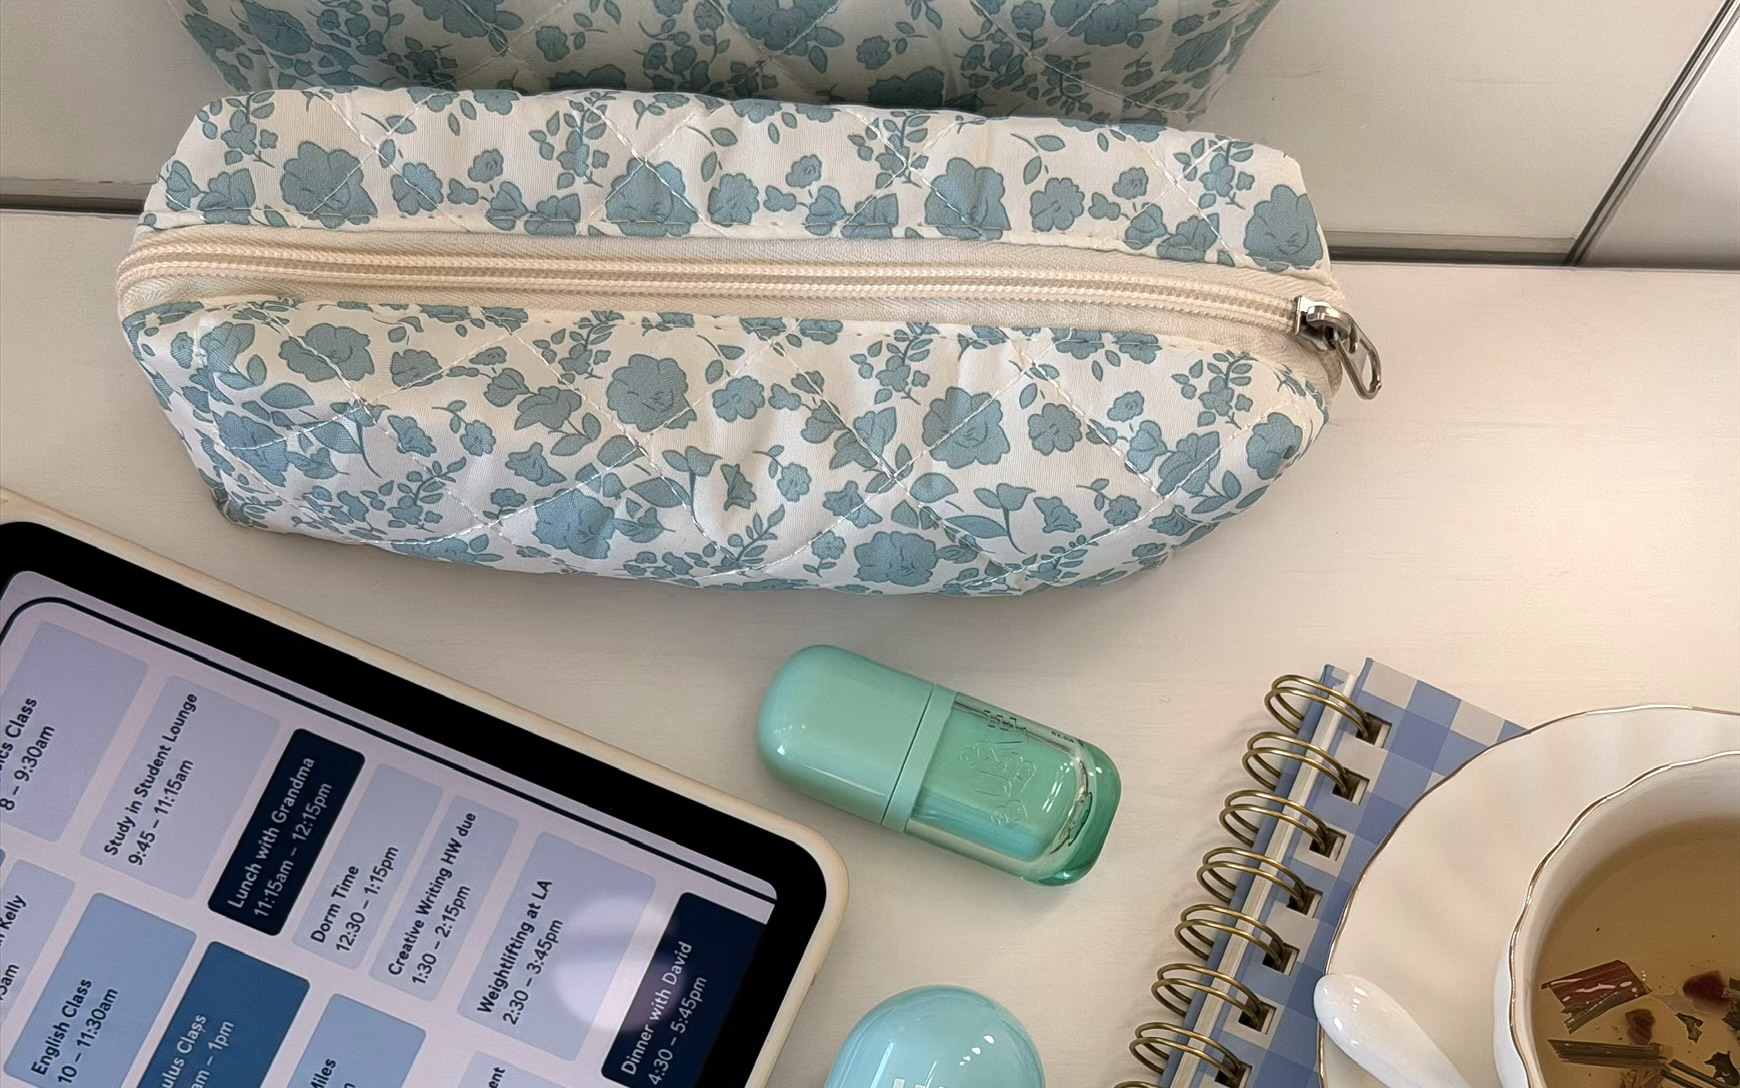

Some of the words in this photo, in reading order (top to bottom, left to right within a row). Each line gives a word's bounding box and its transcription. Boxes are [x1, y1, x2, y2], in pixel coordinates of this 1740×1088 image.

[5, 698, 37, 738] Class
[161, 693, 198, 743] Lounge
[0, 798, 15, 811] 8
[14, 726, 55, 782] 9:30am
[124, 800, 143, 814] in
[133, 744, 172, 798] Student
[103, 815, 136, 856] Study
[128, 830, 156, 866] 9:45
[153, 760, 194, 815] 11:15am
[227, 863, 262, 908] Lunch
[255, 827, 280, 859] with
[271, 758, 315, 823] Grandma
[254, 860, 294, 916] 11:15am
[292, 783, 332, 841] 12:15pm
[0, 895, 27, 930] Kelly
[310, 903, 341, 943] Dorm
[330, 865, 359, 899] Time
[335, 911, 366, 951] 12:30
[363, 846, 399, 895] 1:15pm
[388, 919, 425, 975] Creative
[415, 867, 453, 915] Writing
[440, 837, 463, 865] HW
[455, 812, 477, 837] due
[411, 953, 437, 984] 1:30
[434, 885, 471, 938] 2:15pm
[526, 902, 542, 920] at
[531, 881, 553, 901] LA
[476, 921, 535, 1013] Weightlifting
[502, 990, 529, 1025] 2:30
[526, 919, 563, 975] 3:45pm
[621, 1024, 654, 1075] Dinner
[648, 988, 672, 1021] with
[661, 941, 692, 986] David
[30, 1021, 71, 1076] English
[61, 979, 92, 1018] Class
[57, 1065, 78, 1083] 10
[76, 988, 118, 1047] 11:30am
[176, 1015, 206, 1054] Class
[208, 1021, 234, 1050] 1pm
[648, 1048, 673, 1085] 4:30
[670, 977, 707, 1034] 5:45pm
